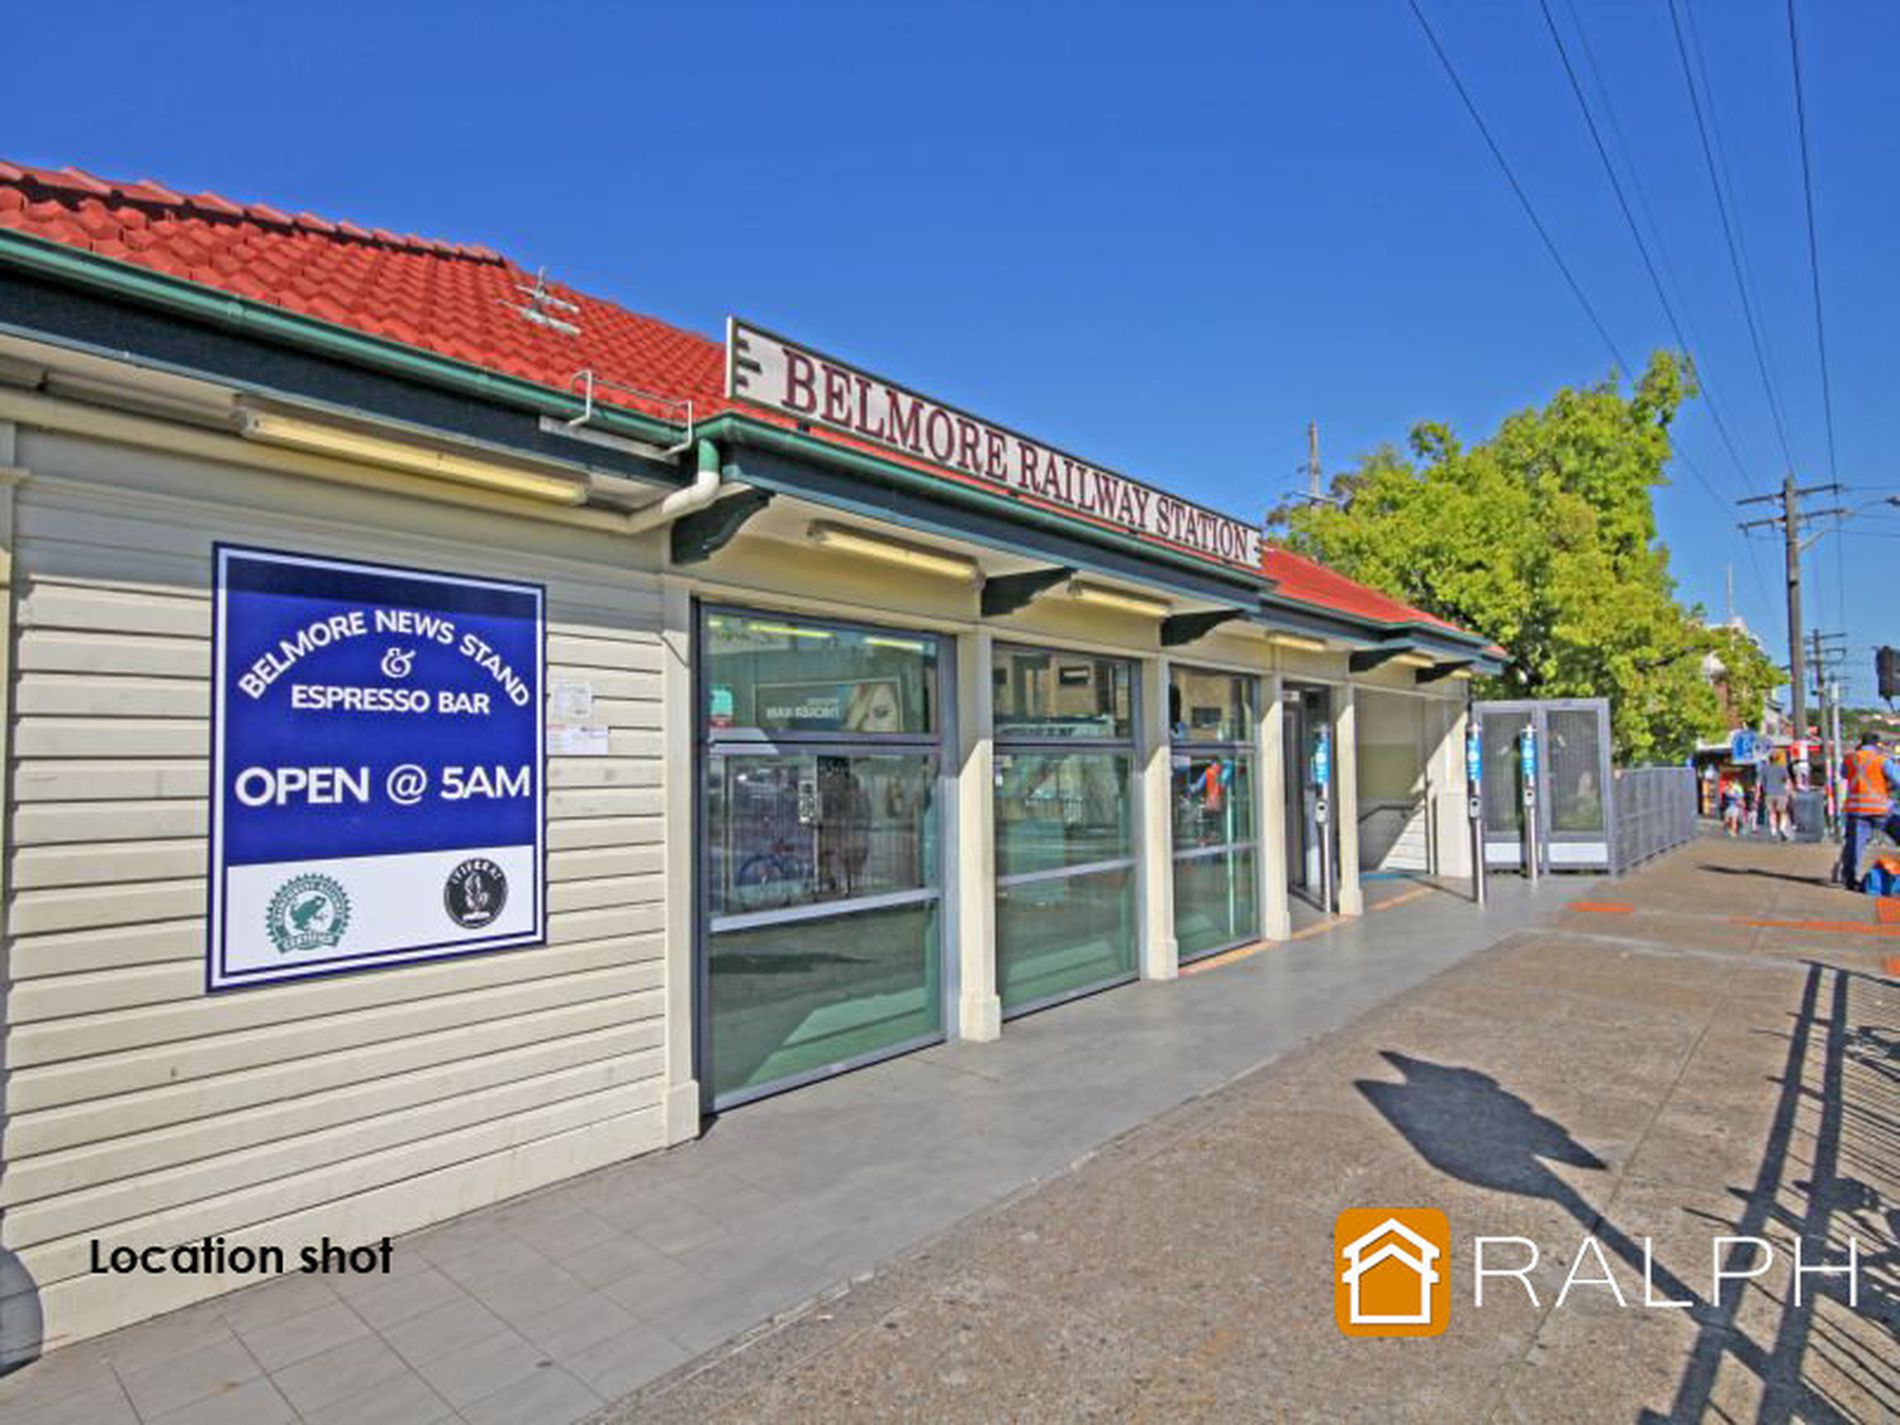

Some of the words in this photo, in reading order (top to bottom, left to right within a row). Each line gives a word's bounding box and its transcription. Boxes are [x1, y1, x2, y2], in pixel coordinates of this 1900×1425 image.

[781, 347, 1008, 482] BELMORE
[1017, 443, 1152, 533] RAILWAY
[1155, 497, 1249, 562] STATION
[239, 611, 367, 698] BELMORE
[375, 610, 455, 644] NEWS
[459, 634, 530, 707] STAND
[381, 647, 415, 679] &
[291, 685, 430, 713] ESPRESSO
[438, 693, 490, 715] BAR
[235, 767, 369, 806] OPEN
[387, 764, 427, 805] @
[440, 765, 531, 800] 5AM
